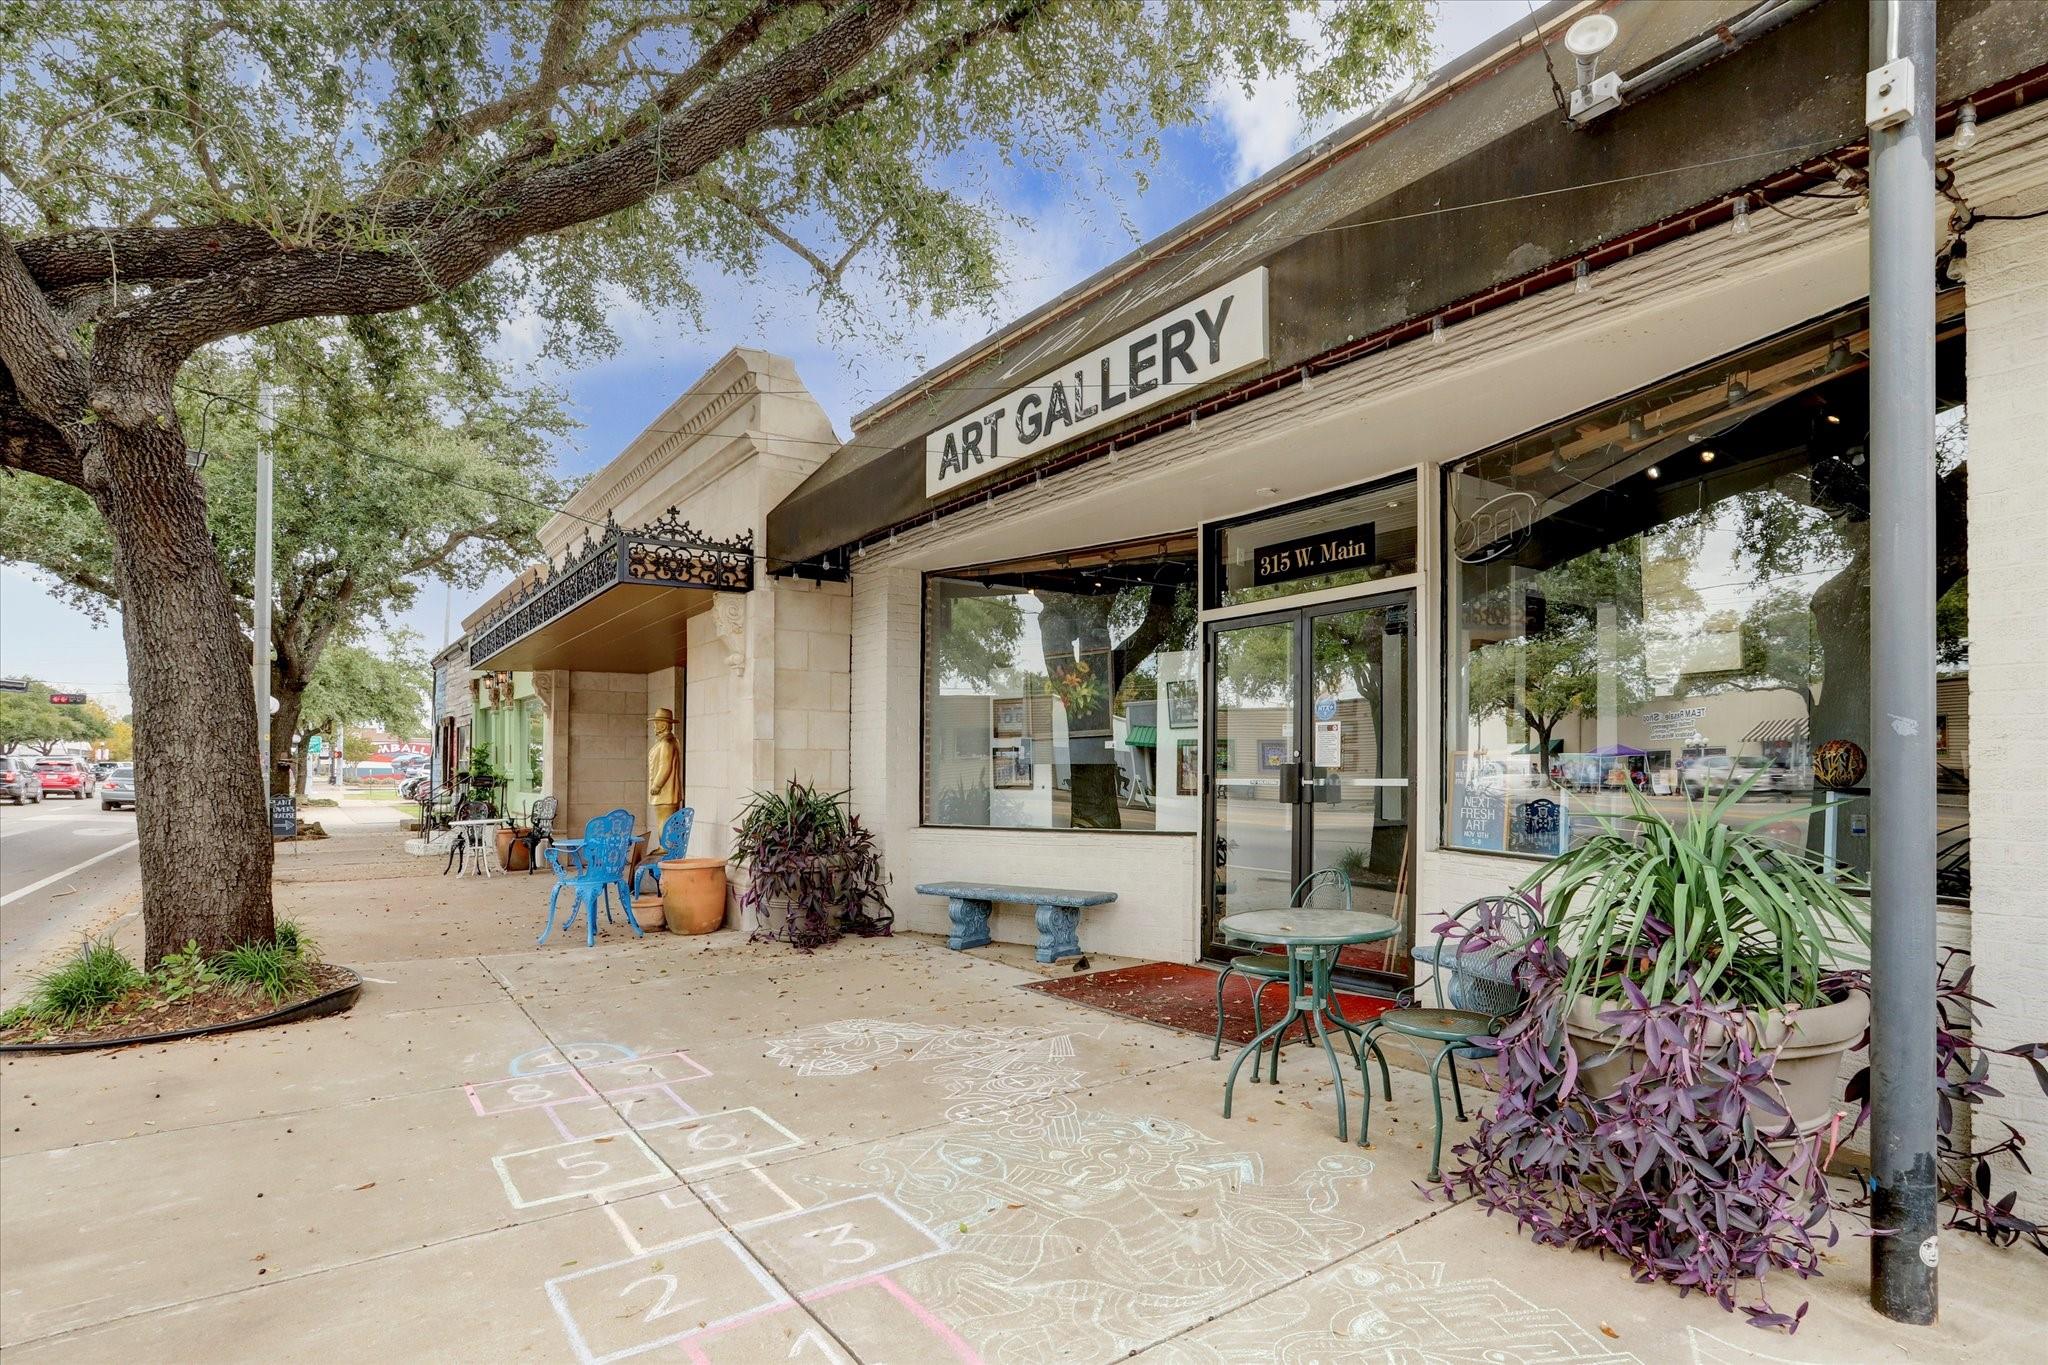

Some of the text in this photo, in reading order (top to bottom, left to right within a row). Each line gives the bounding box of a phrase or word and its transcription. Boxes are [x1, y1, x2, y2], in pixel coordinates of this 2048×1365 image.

[938, 295, 1235, 481] ART GALLERY
[1454, 501, 1532, 553] OPEN
[1260, 540, 1366, 576] 315 W. Main
[1460, 807, 1495, 820] FRESH
[1464, 796, 1490, 808] NEXT
[1463, 830, 1475, 838] NOV
[1465, 819, 1486, 831] ART
[507, 1083, 555, 1102] 8
[686, 1124, 739, 1151] 6
[557, 1151, 611, 1181] 5
[656, 1182, 732, 1213] 4
[801, 1222, 878, 1265] 3
[618, 1273, 708, 1322] 2
